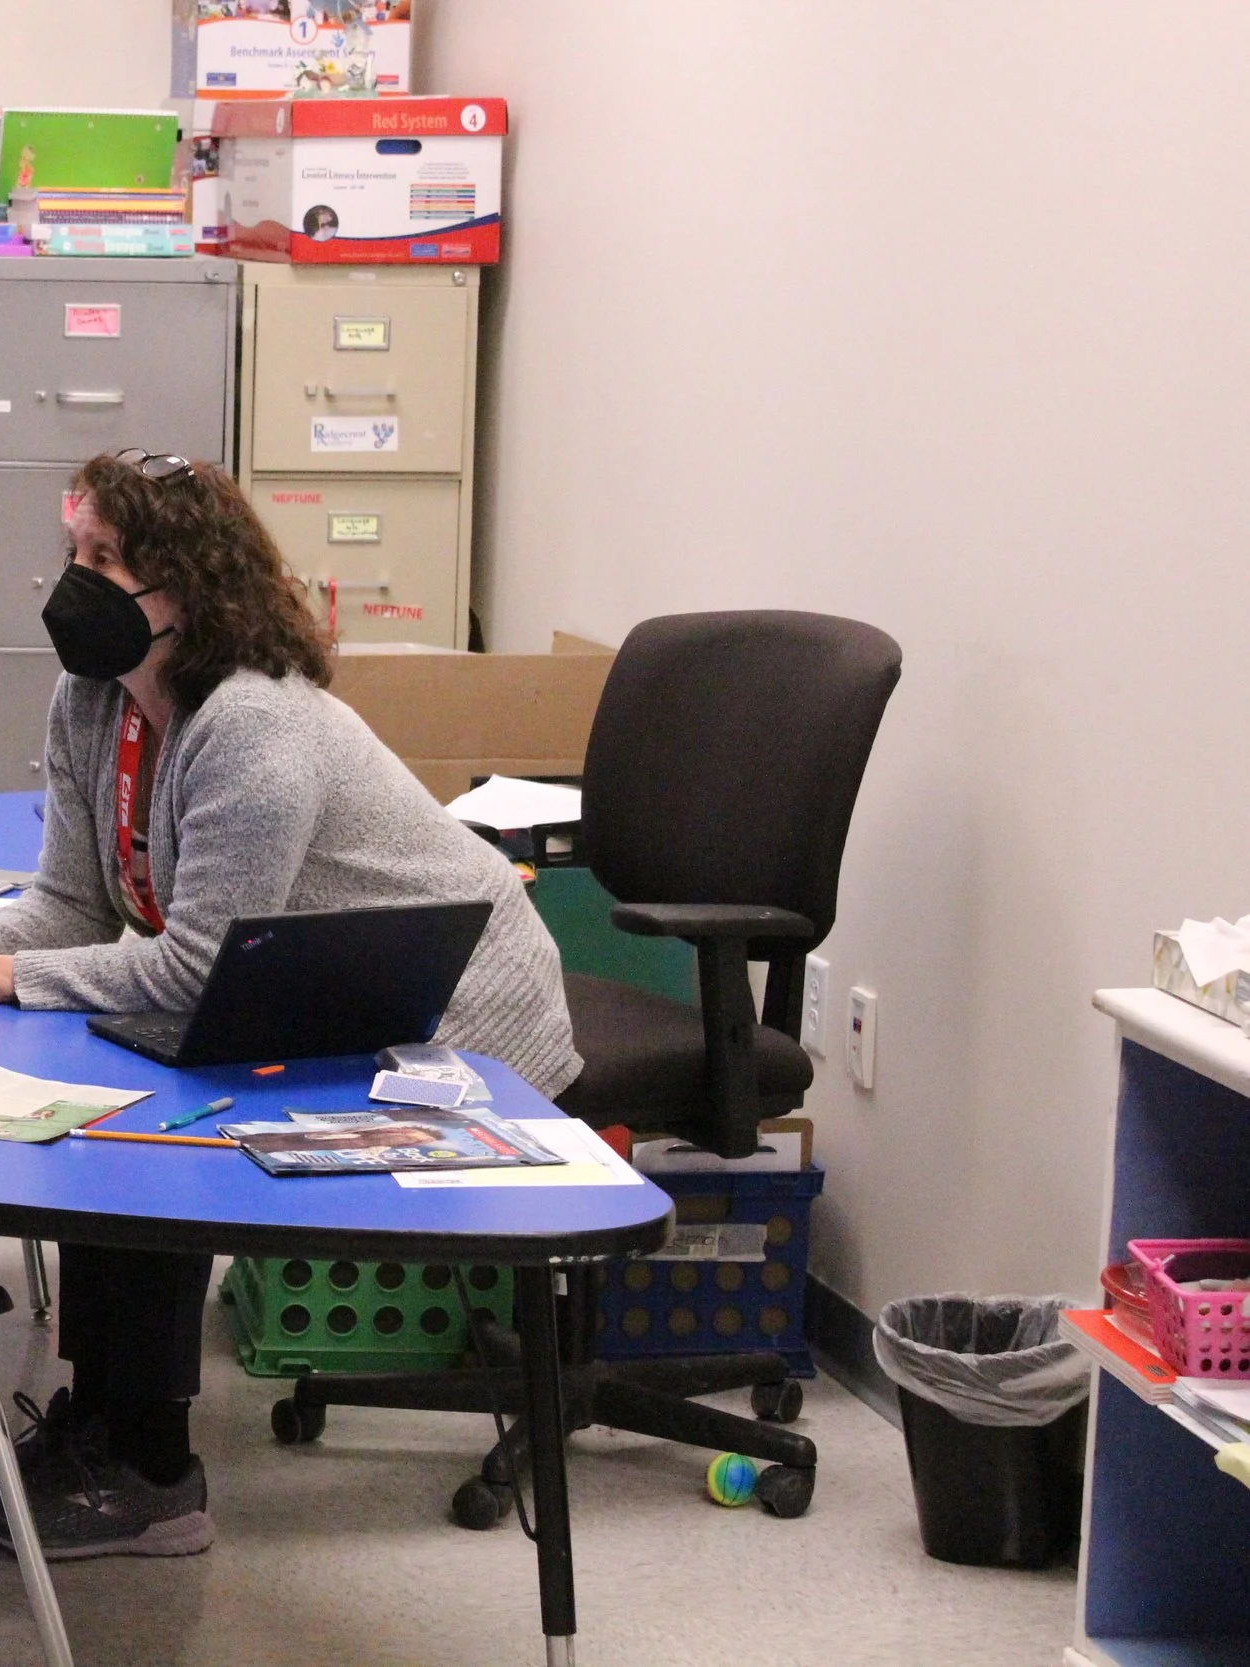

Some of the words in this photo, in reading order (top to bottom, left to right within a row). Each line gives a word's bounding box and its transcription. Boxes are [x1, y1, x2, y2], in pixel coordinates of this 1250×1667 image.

[299, 21, 307, 38] 1
[230, 45, 283, 57] Benchmark
[286, 46, 339, 58] Assessent
[372, 113, 398, 129] Red
[400, 113, 448, 132] System
[469, 114, 478, 128] 4
[329, 168, 355, 180] Literacy
[356, 169, 397, 180] Intervention
[272, 493, 321, 504] NEPTUNE
[363, 603, 423, 620] NEPTUNE
